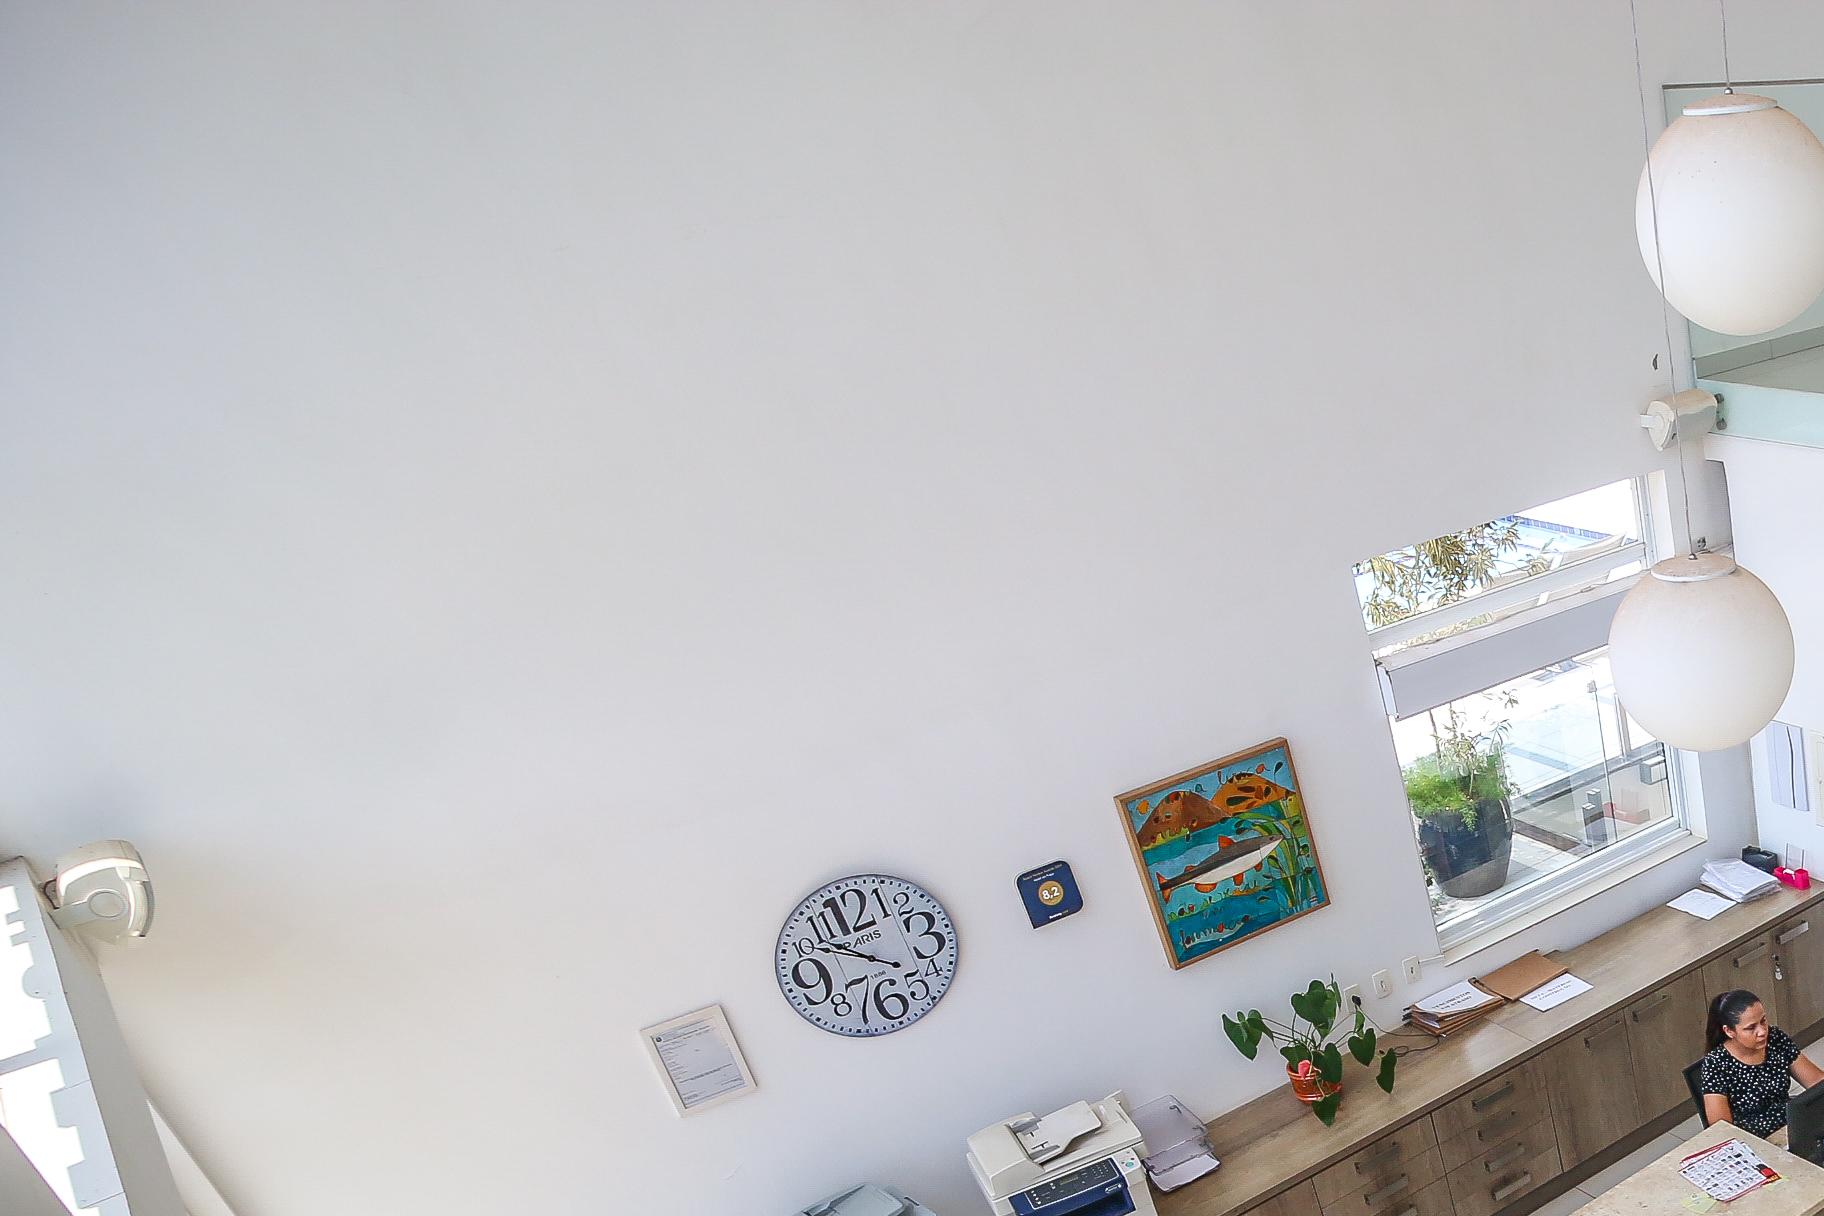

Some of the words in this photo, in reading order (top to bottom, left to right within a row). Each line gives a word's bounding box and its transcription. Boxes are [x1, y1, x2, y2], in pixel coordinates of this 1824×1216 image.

[893, 891, 916, 917] 2
[1041, 886, 1060, 900] 8,2
[805, 909, 839, 945] 11
[822, 887, 877, 937] 12
[791, 937, 815, 959] 10
[904, 911, 947, 960] 3
[791, 957, 834, 1007] 9
[904, 968, 930, 1002] 5
[924, 959, 944, 979] 4
[830, 992, 853, 1018] 8
[845, 974, 870, 1026] 7
[873, 978, 910, 1022] 6
